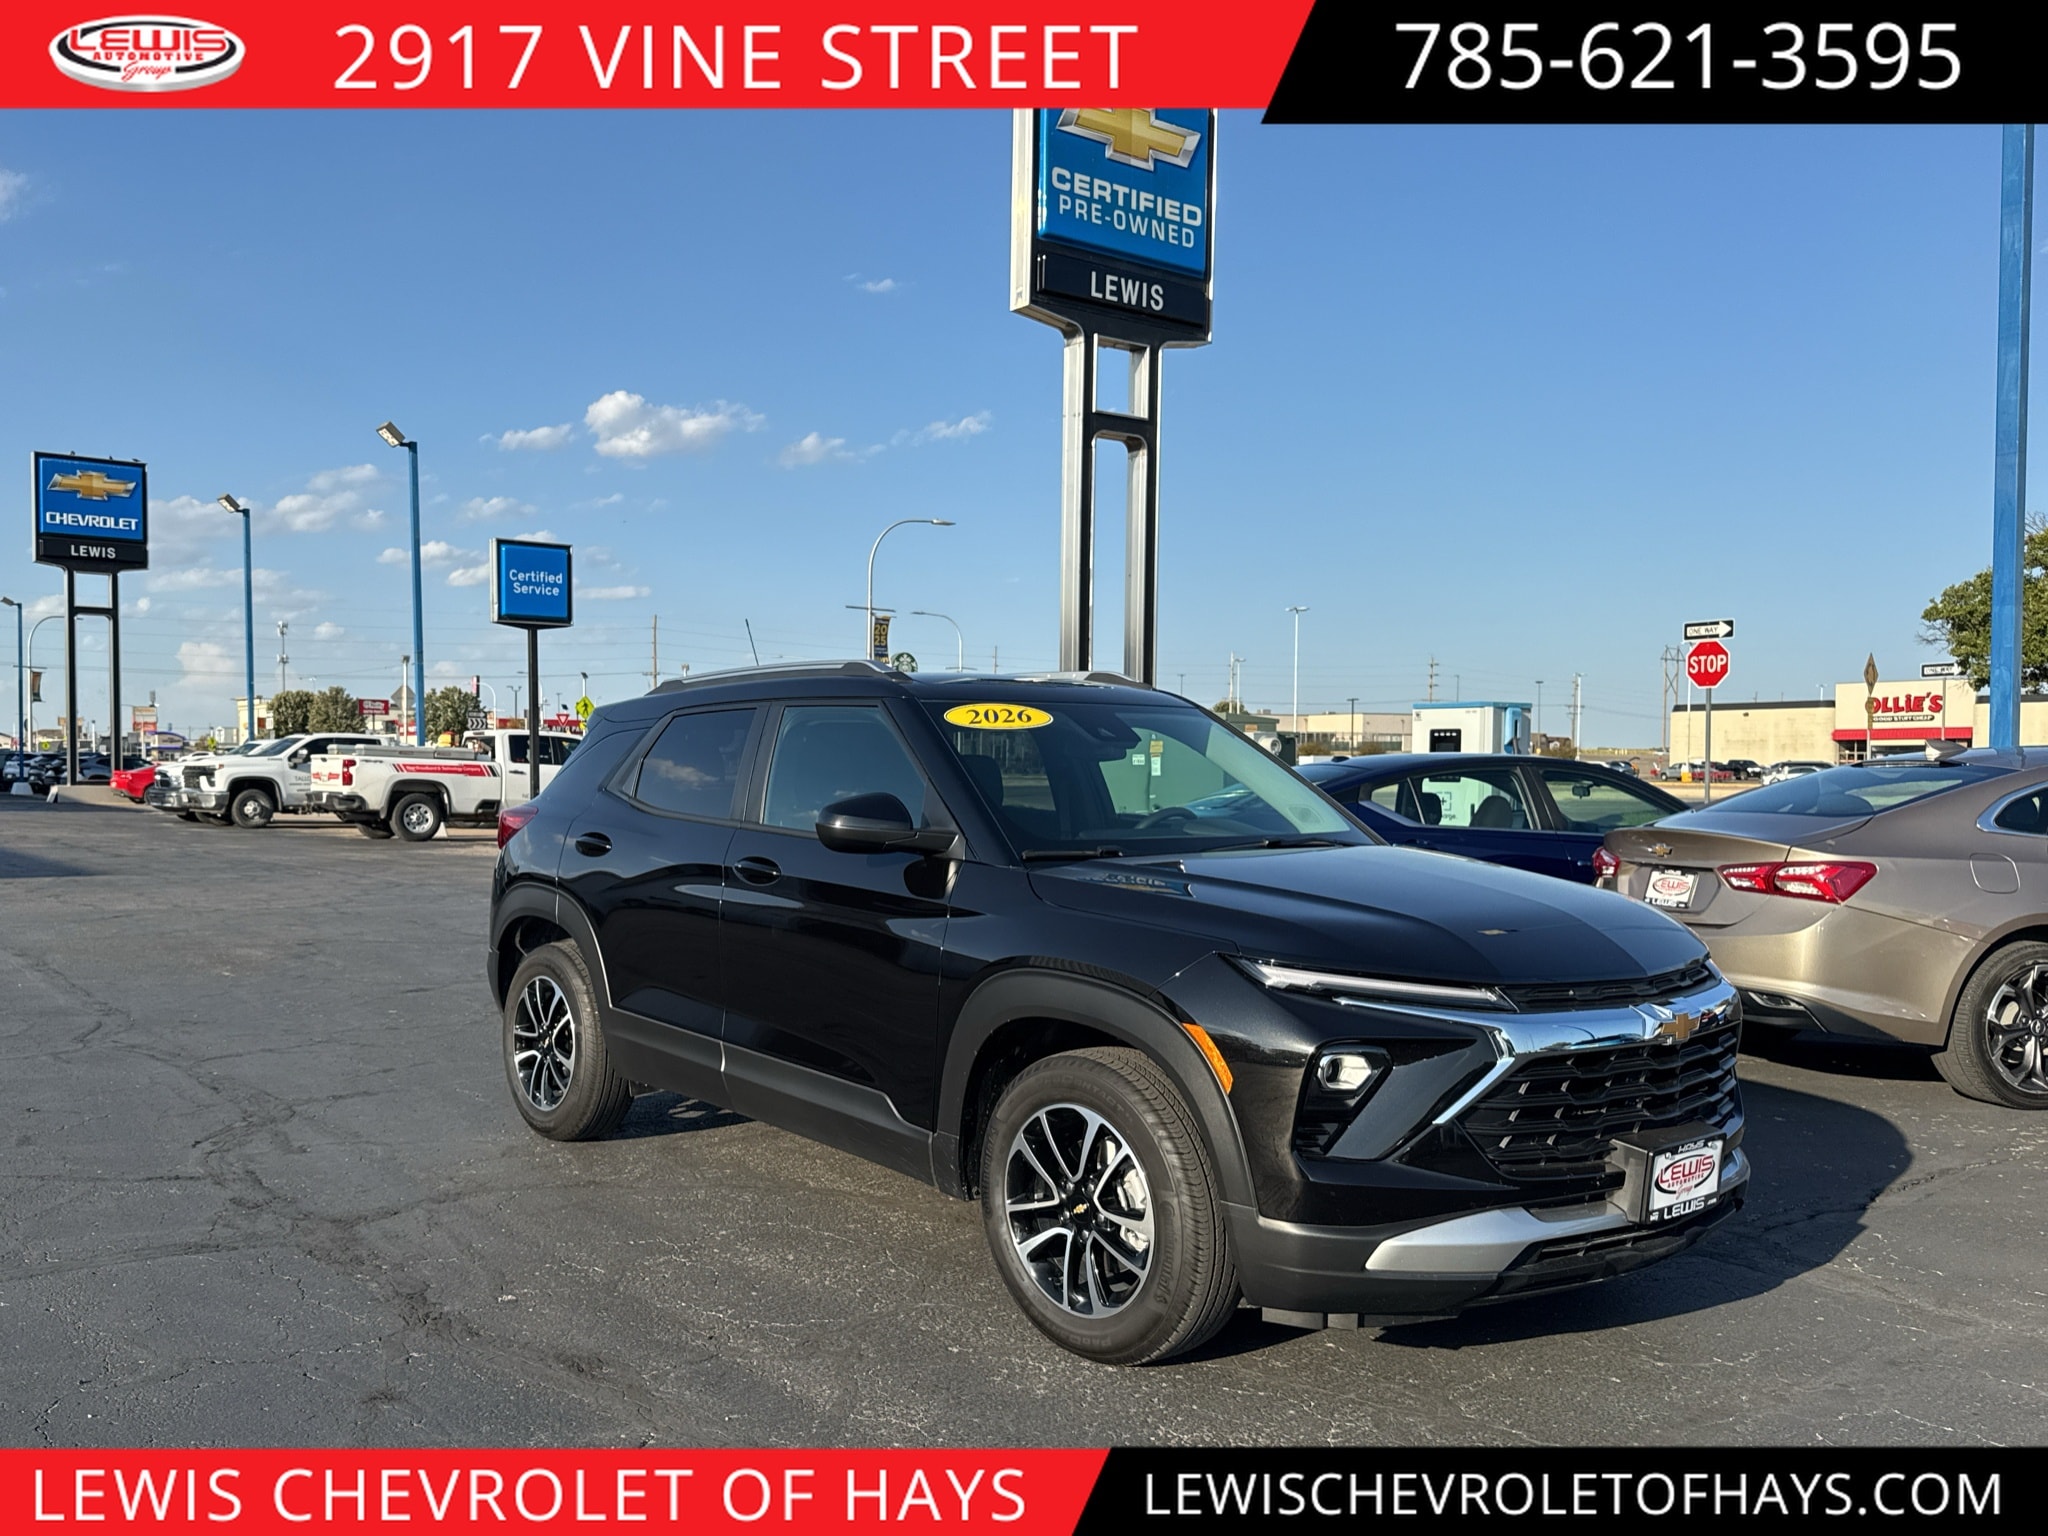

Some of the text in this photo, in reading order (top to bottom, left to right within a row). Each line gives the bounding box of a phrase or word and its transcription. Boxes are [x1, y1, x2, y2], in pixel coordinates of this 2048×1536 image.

[1052, 166, 1202, 226] CERTIFIED
[1059, 195, 1195, 248] PRE-OWNED
[1091, 271, 1163, 311] LEWIS
[46, 511, 139, 531] CHEVROLET
[71, 545, 116, 559] LEWIS
[509, 569, 563, 584] Certified
[513, 582, 560, 596] Service
[1704, 626, 1719, 634] WAY
[1689, 654, 1727, 674] STOP
[966, 708, 1032, 725] 2026
[1659, 1155, 1714, 1184] LEWIS
[1663, 1197, 1705, 1220] LEWIS
